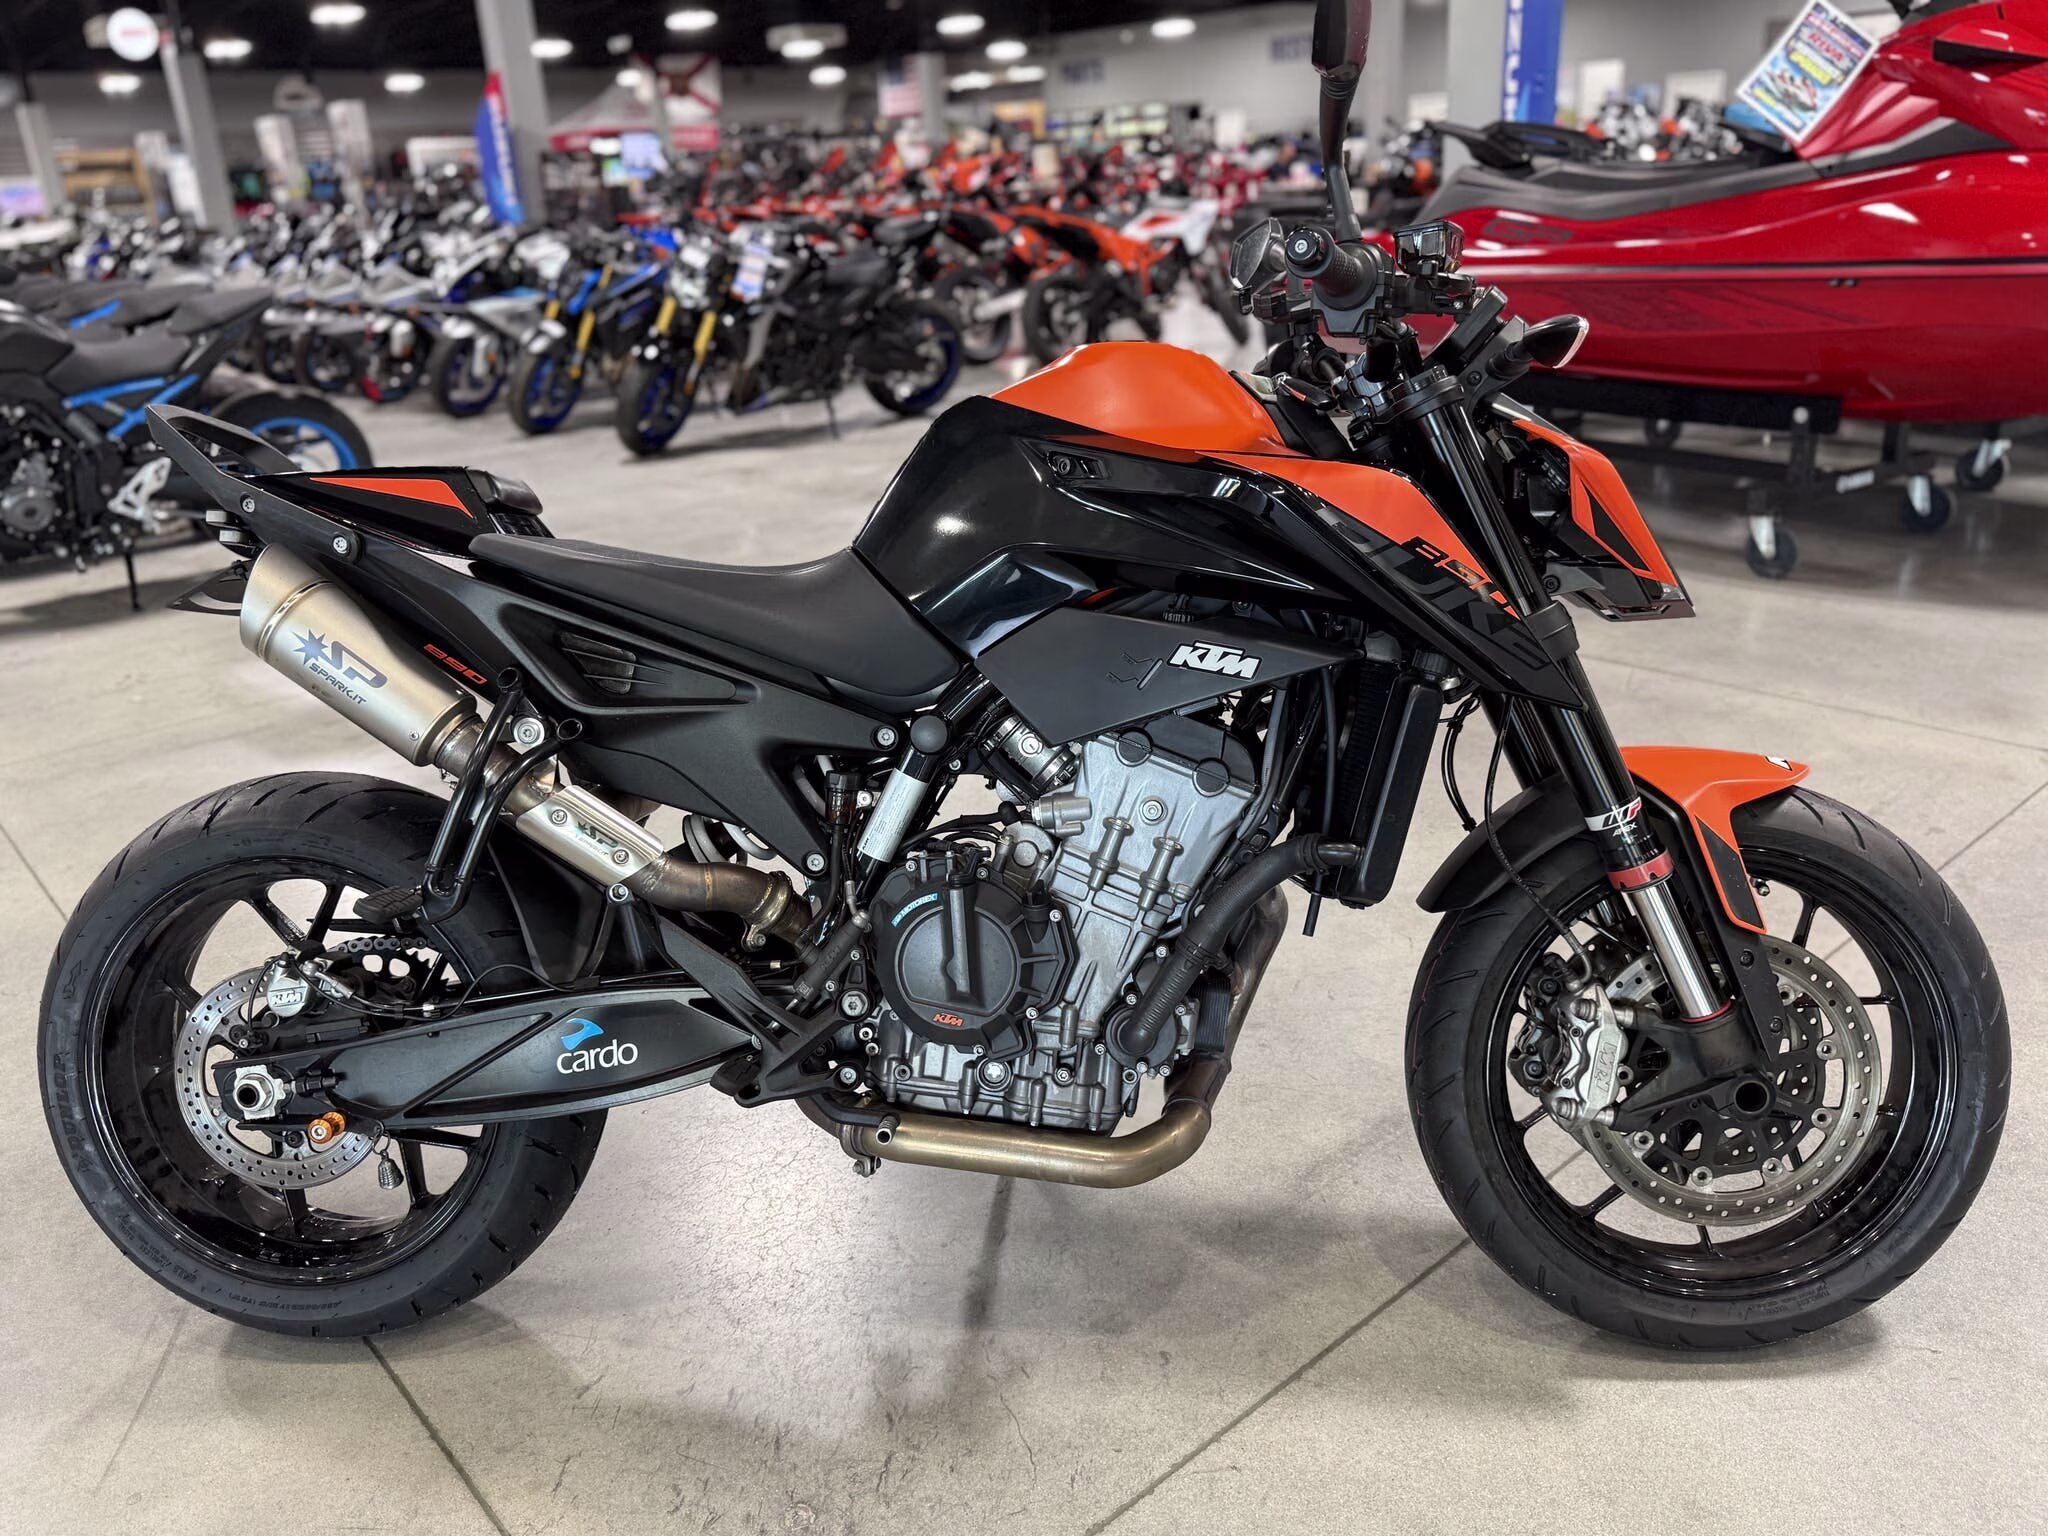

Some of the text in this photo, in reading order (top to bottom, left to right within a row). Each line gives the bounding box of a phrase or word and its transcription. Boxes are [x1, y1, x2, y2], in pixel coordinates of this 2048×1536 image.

[1809, 33, 1844, 63] RIVA
[1314, 505, 1547, 671] DUKE
[423, 643, 487, 685] 890
[1169, 642, 1260, 679] KTM
[271, 989, 303, 1007] KTM
[933, 1013, 963, 1026] KTM
[556, 1039, 639, 1074] cardo
[1594, 1042, 1618, 1093] KTM
